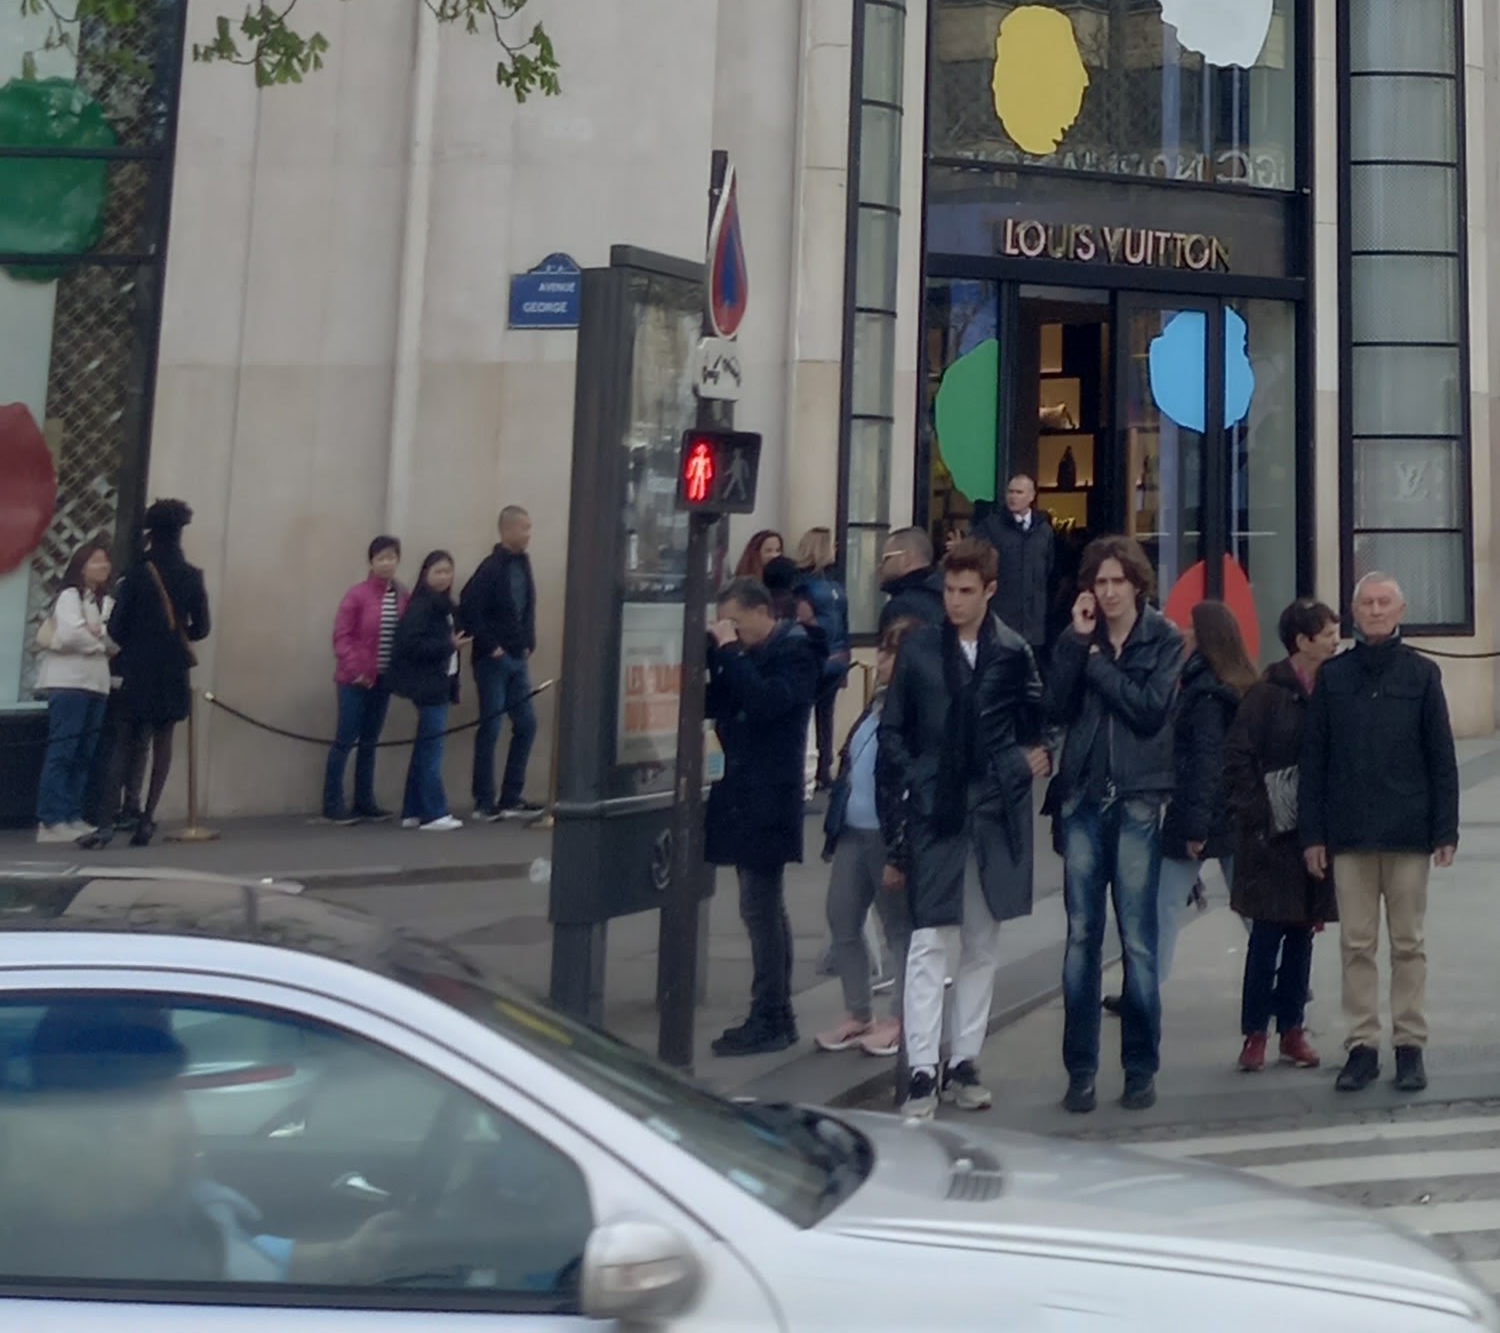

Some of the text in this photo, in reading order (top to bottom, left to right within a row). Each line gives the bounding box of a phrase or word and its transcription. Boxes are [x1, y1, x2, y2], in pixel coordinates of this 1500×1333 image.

[1004, 218, 1231, 272] LOUIS VUITTON
[522, 301, 568, 314] GEORGE
